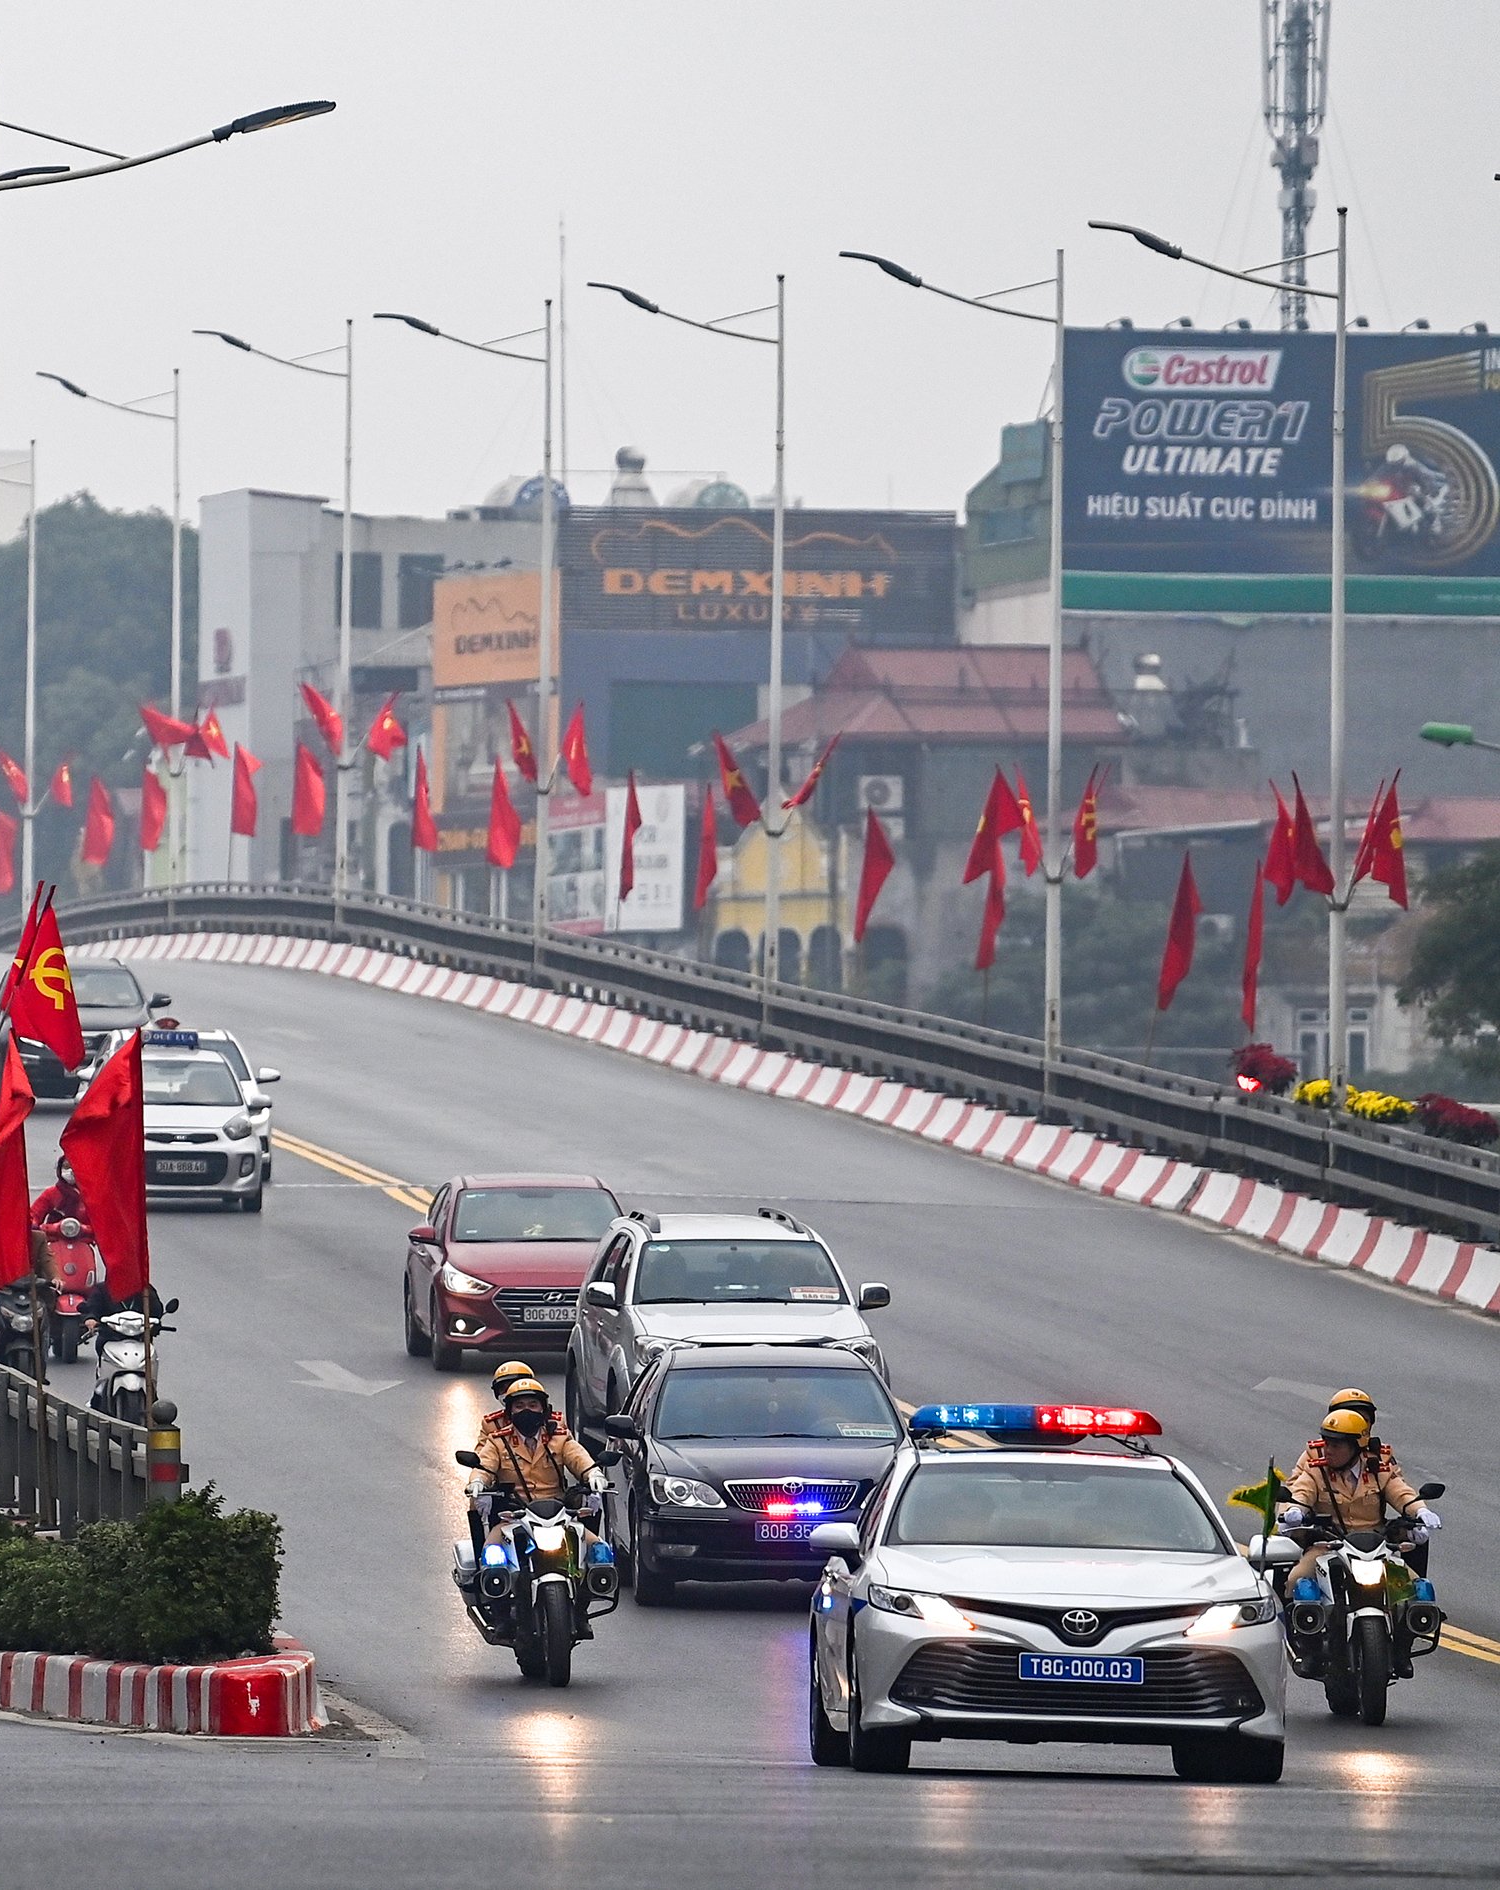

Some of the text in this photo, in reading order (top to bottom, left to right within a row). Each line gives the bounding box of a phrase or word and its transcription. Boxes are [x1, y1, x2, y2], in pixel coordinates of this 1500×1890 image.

[1162, 354, 1269, 385] Castrol
[1093, 397, 1311, 442] POWER1
[1122, 446, 1284, 476] ULTIMATE
